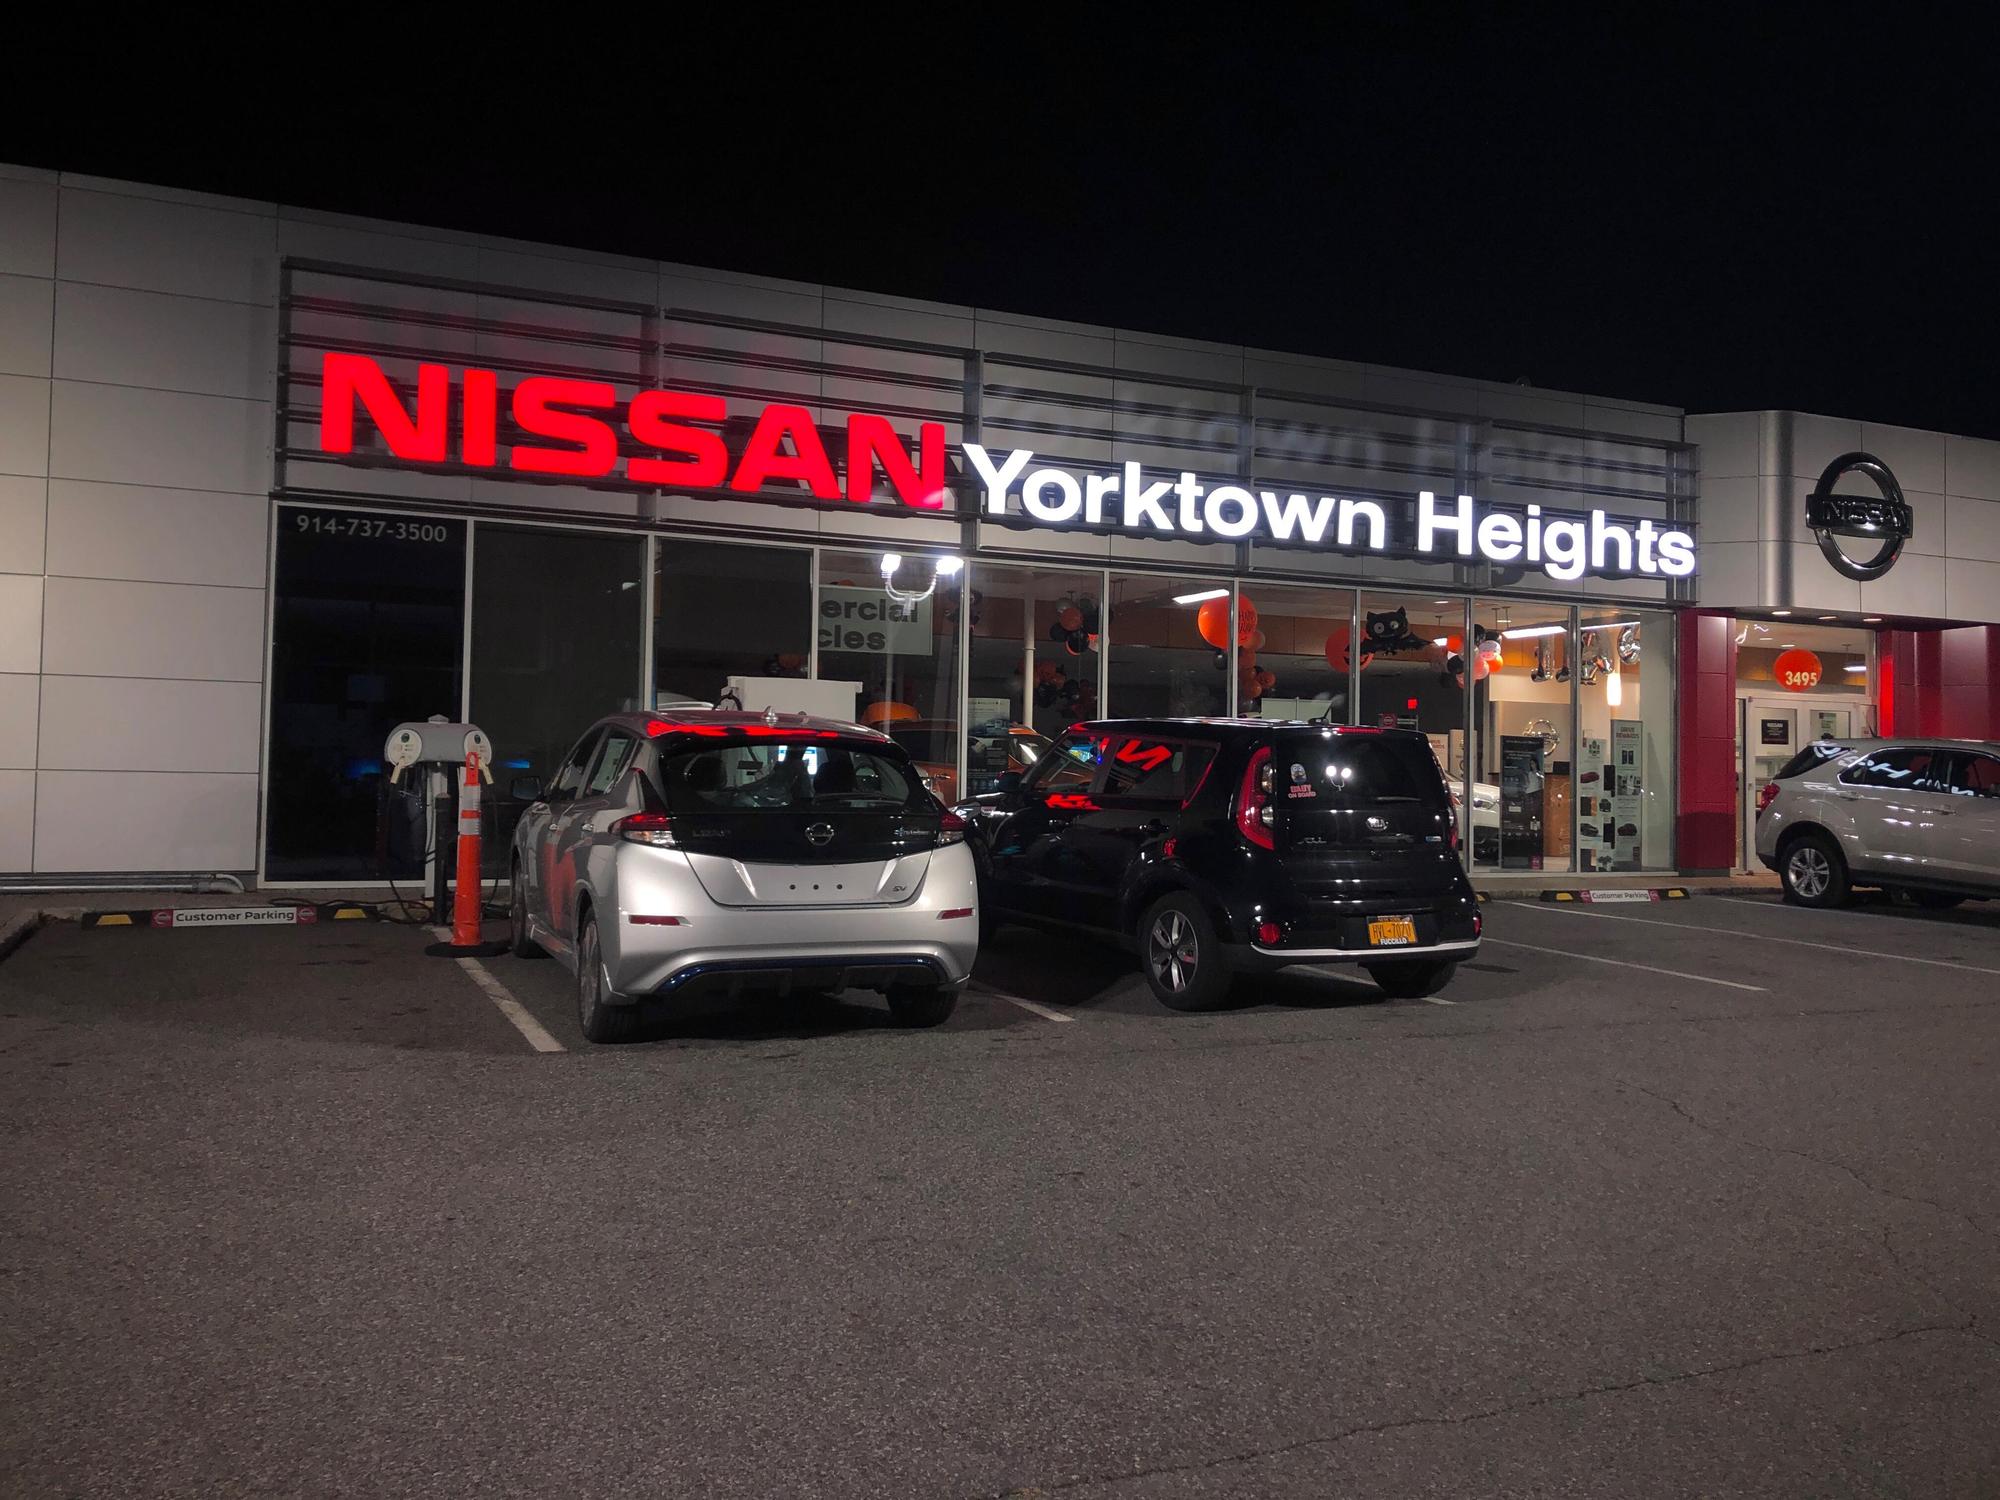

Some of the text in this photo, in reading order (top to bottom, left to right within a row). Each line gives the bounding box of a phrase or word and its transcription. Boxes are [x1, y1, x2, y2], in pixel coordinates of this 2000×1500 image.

[320, 352, 1697, 581] NISSAN Yorktown Heights
[296, 514, 447, 543] 914-737-3500
[1785, 670, 1818, 687] 3495
[1624, 892, 1650, 900] Parking
[175, 910, 295, 922] Customer Parking
